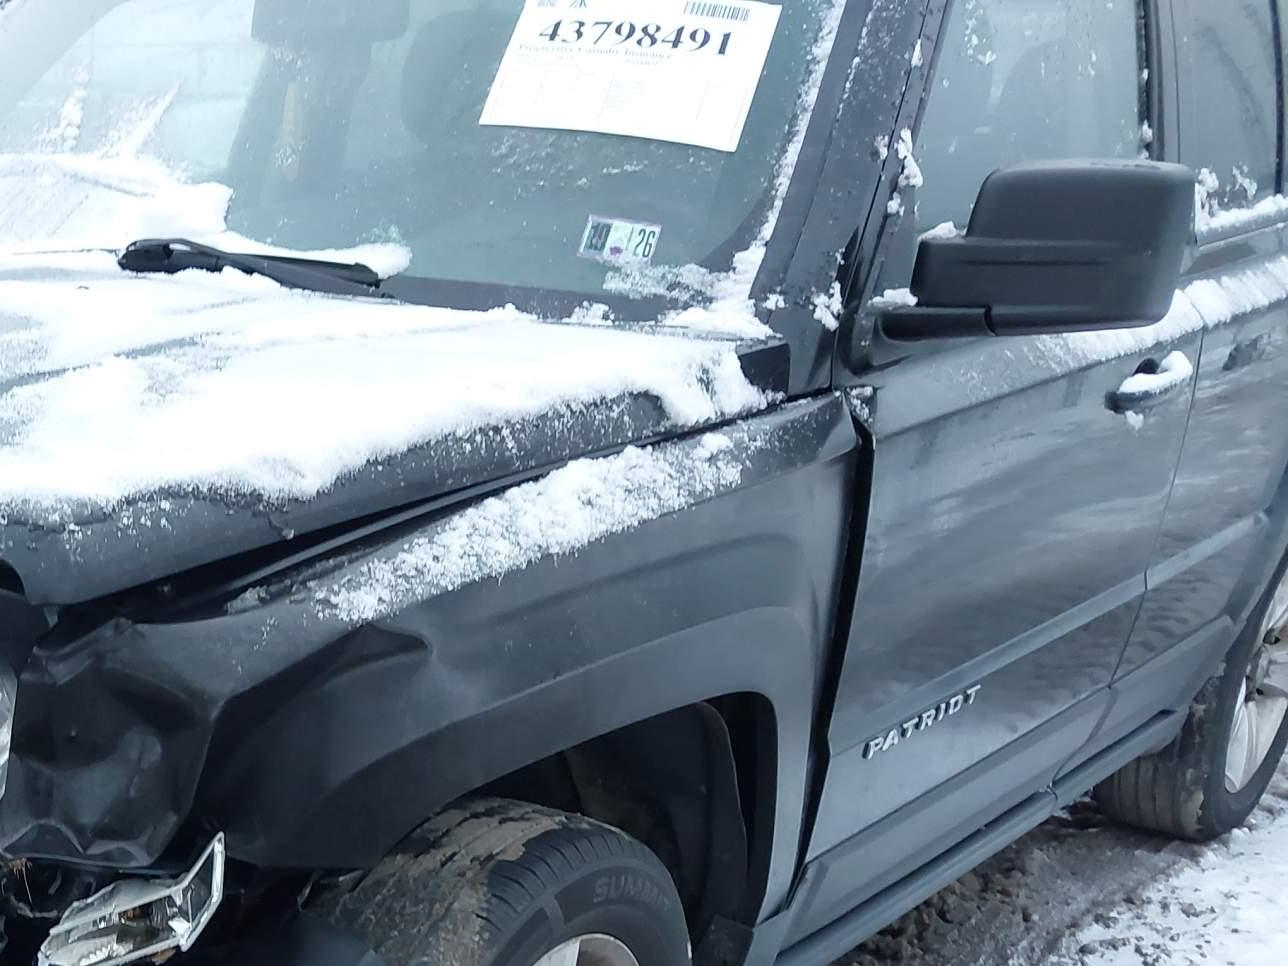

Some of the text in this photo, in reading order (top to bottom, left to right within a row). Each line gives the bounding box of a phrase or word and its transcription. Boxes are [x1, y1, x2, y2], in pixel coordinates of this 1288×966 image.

[539, 19, 733, 56] 43798491
[633, 227, 656, 258] 26
[862, 683, 982, 760] PATRIOT
